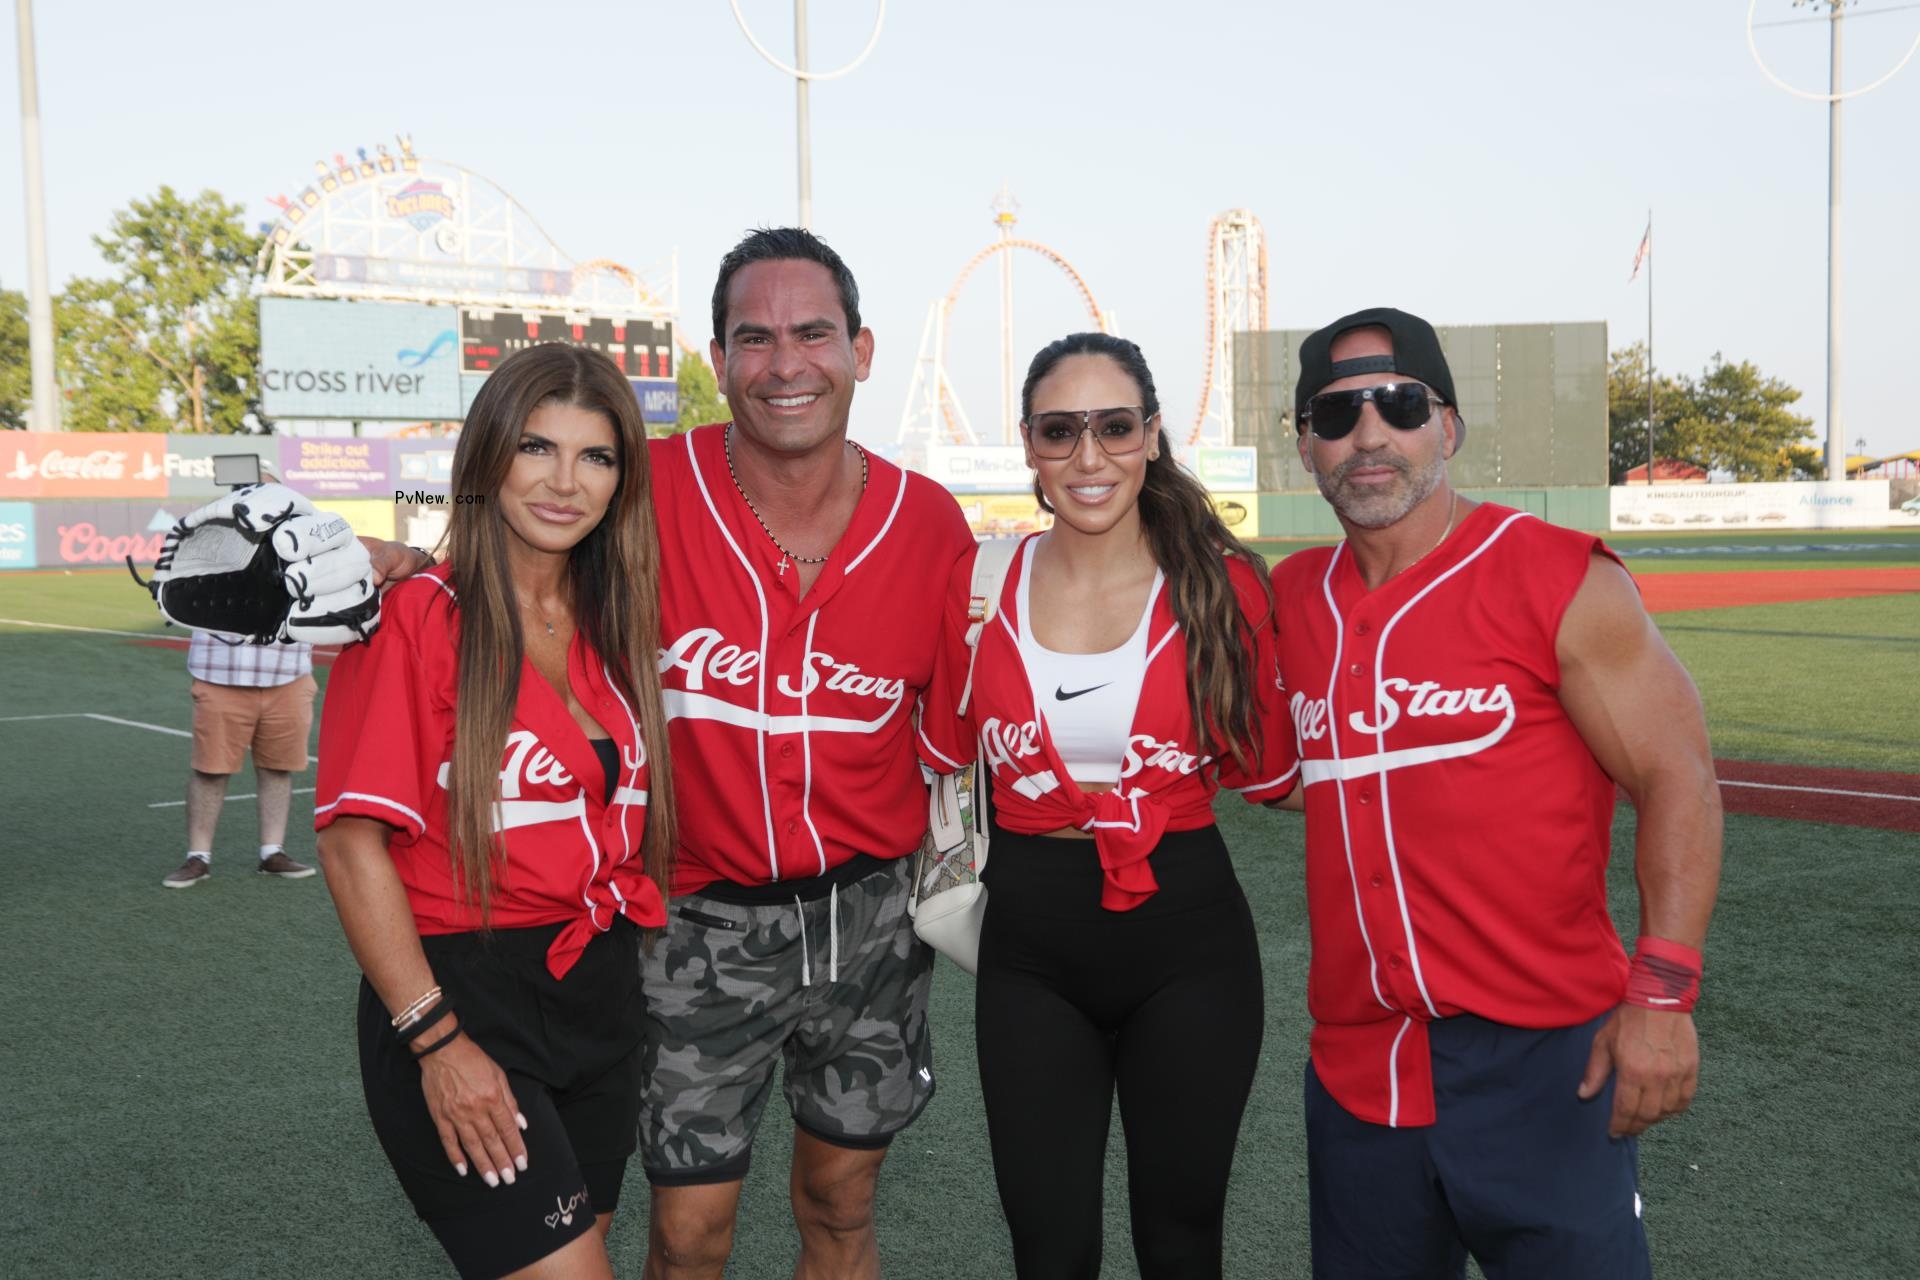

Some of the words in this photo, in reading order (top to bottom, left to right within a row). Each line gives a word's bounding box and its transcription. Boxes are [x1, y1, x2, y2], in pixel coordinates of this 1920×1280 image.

[263, 369, 347, 392] cross
[356, 364, 425, 394] river
[645, 390, 677, 412] MPH
[40, 449, 127, 480] Coca-Cola
[301, 441, 343, 456] Strike
[345, 444, 370, 456] out
[57, 521, 164, 563] Coors
[658, 627, 760, 690] All
[776, 651, 906, 701] Stars
[1348, 677, 1514, 735] Stars
[981, 716, 1041, 777] All
